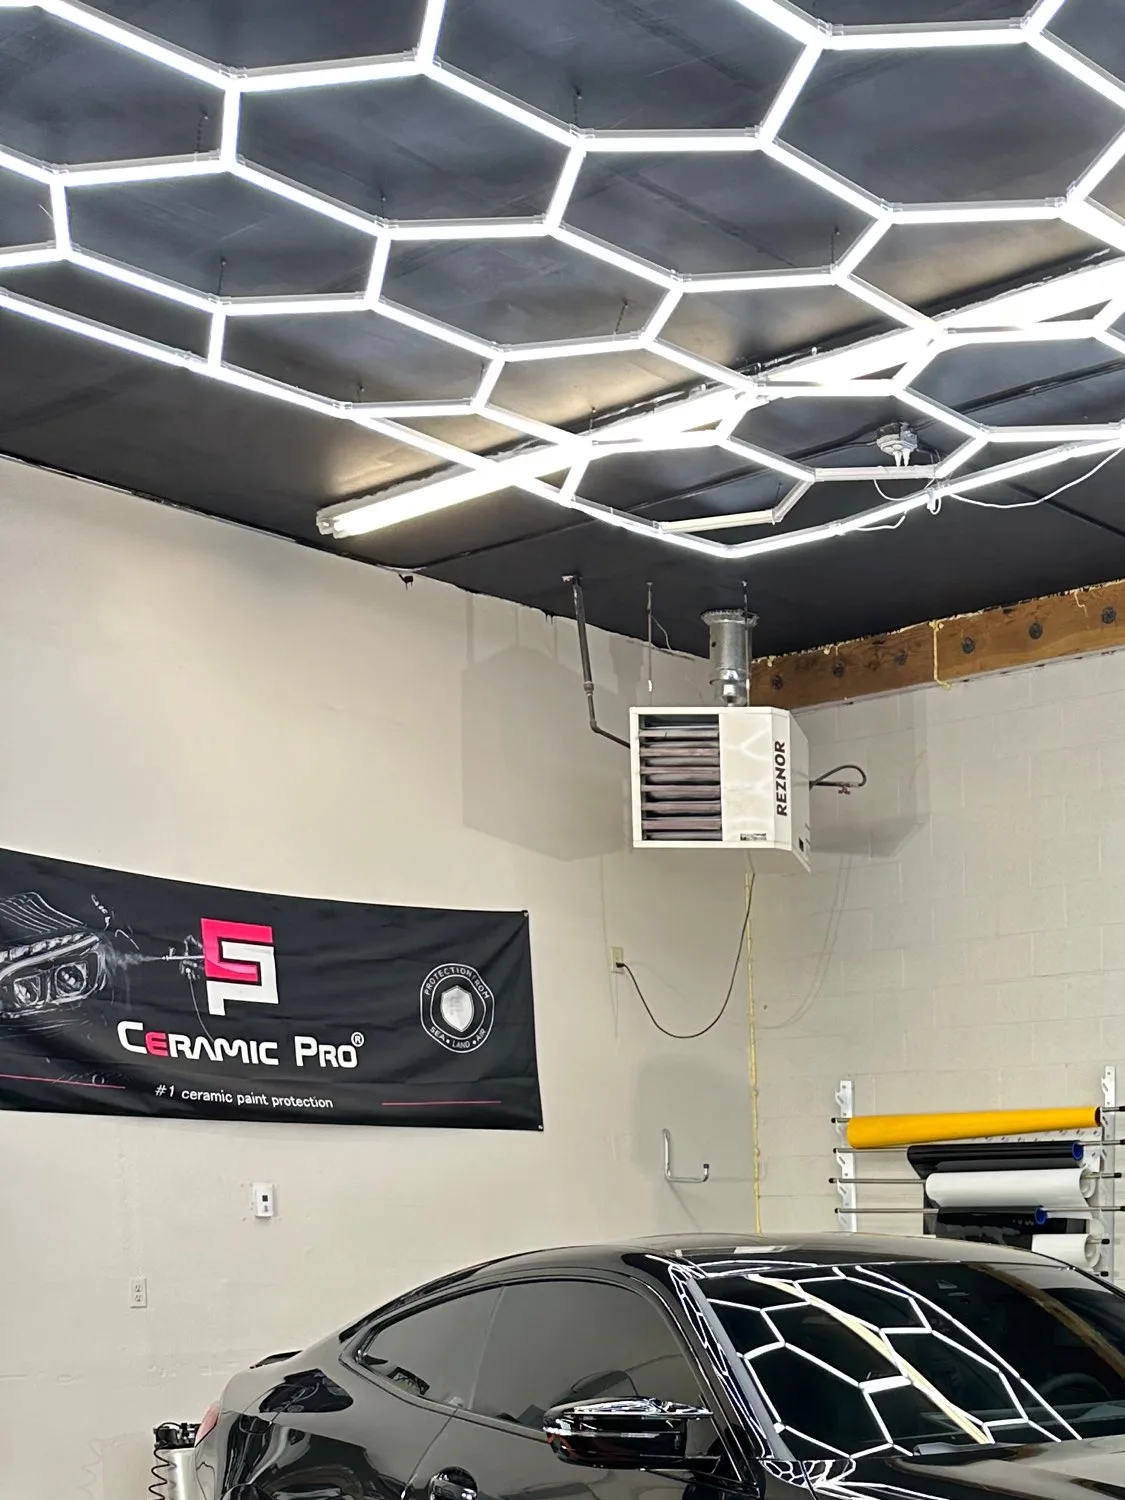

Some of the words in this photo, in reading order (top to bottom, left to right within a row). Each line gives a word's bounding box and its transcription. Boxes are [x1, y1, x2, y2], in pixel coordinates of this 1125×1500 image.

[774, 741, 787, 816] REZNOR
[424, 967, 473, 995] PROTECTION
[429, 1026, 445, 1041] SEA
[452, 1040, 471, 1048] LAND
[476, 1028, 487, 1041] AIR
[155, 1084, 175, 1097] #1
[181, 1089, 233, 1103] ceramic
[237, 1094, 270, 1106] paint
[272, 1095, 334, 1108] protection
